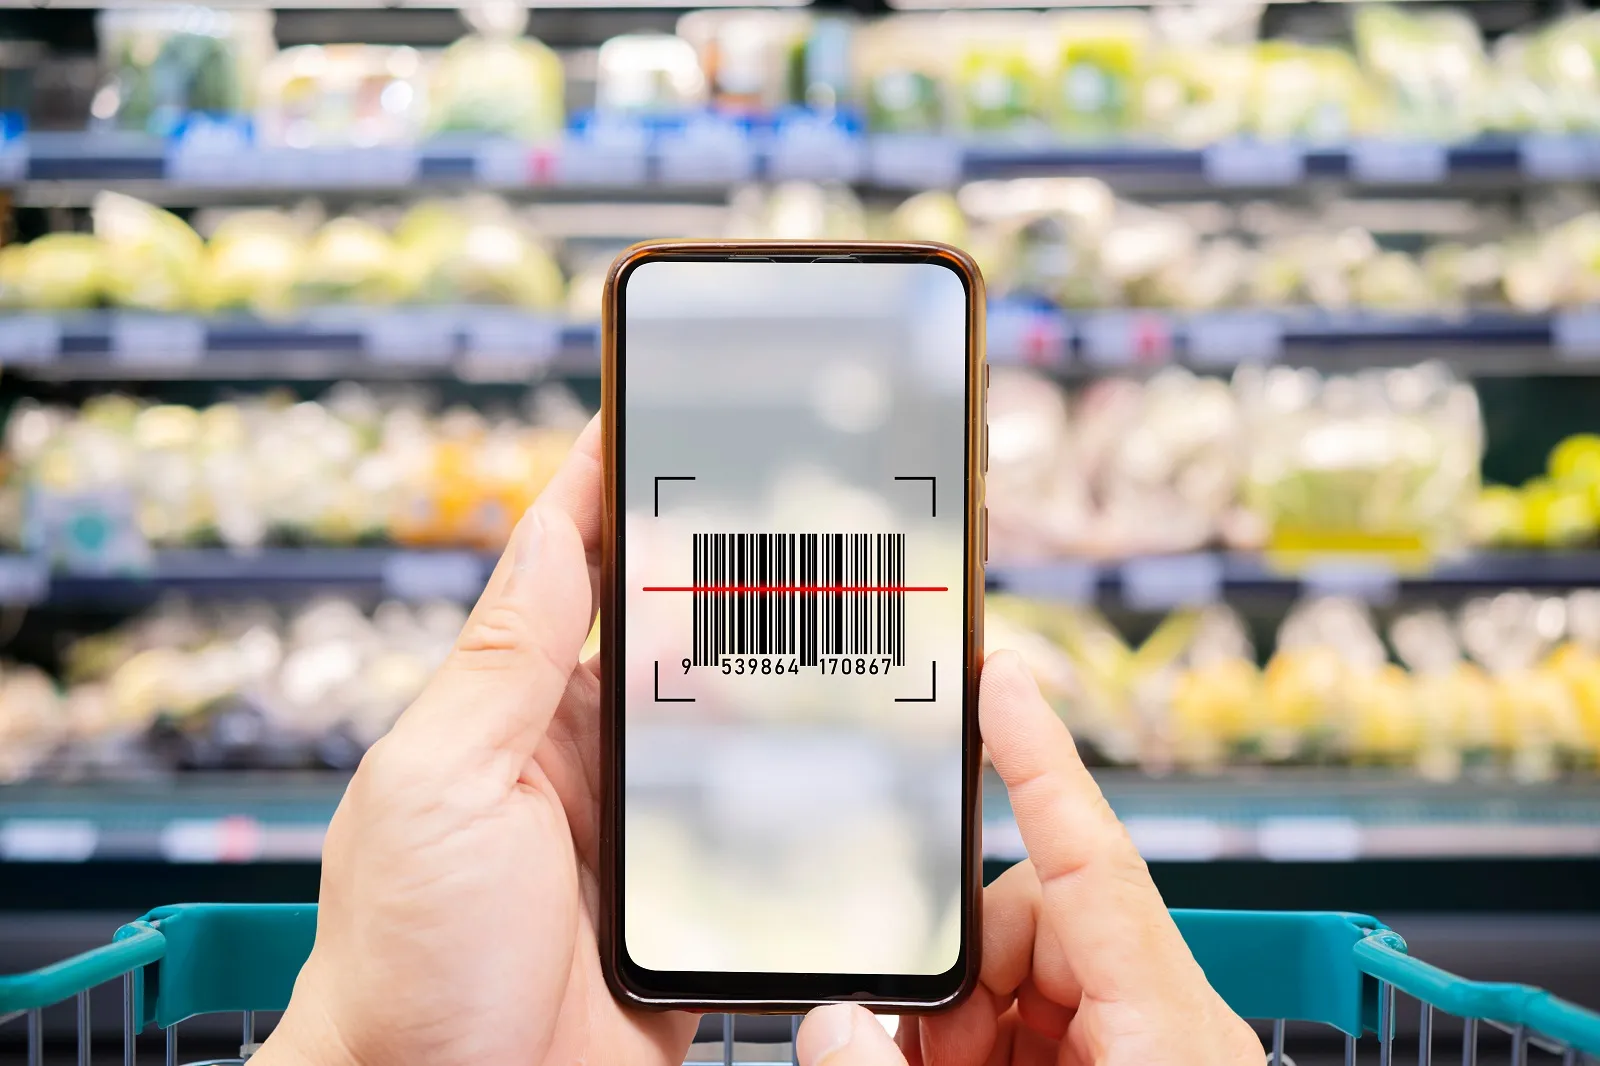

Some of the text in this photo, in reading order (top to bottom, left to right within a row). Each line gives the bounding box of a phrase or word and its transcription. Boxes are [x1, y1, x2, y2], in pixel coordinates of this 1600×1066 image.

[681, 658, 892, 675] 9 539864 170867
